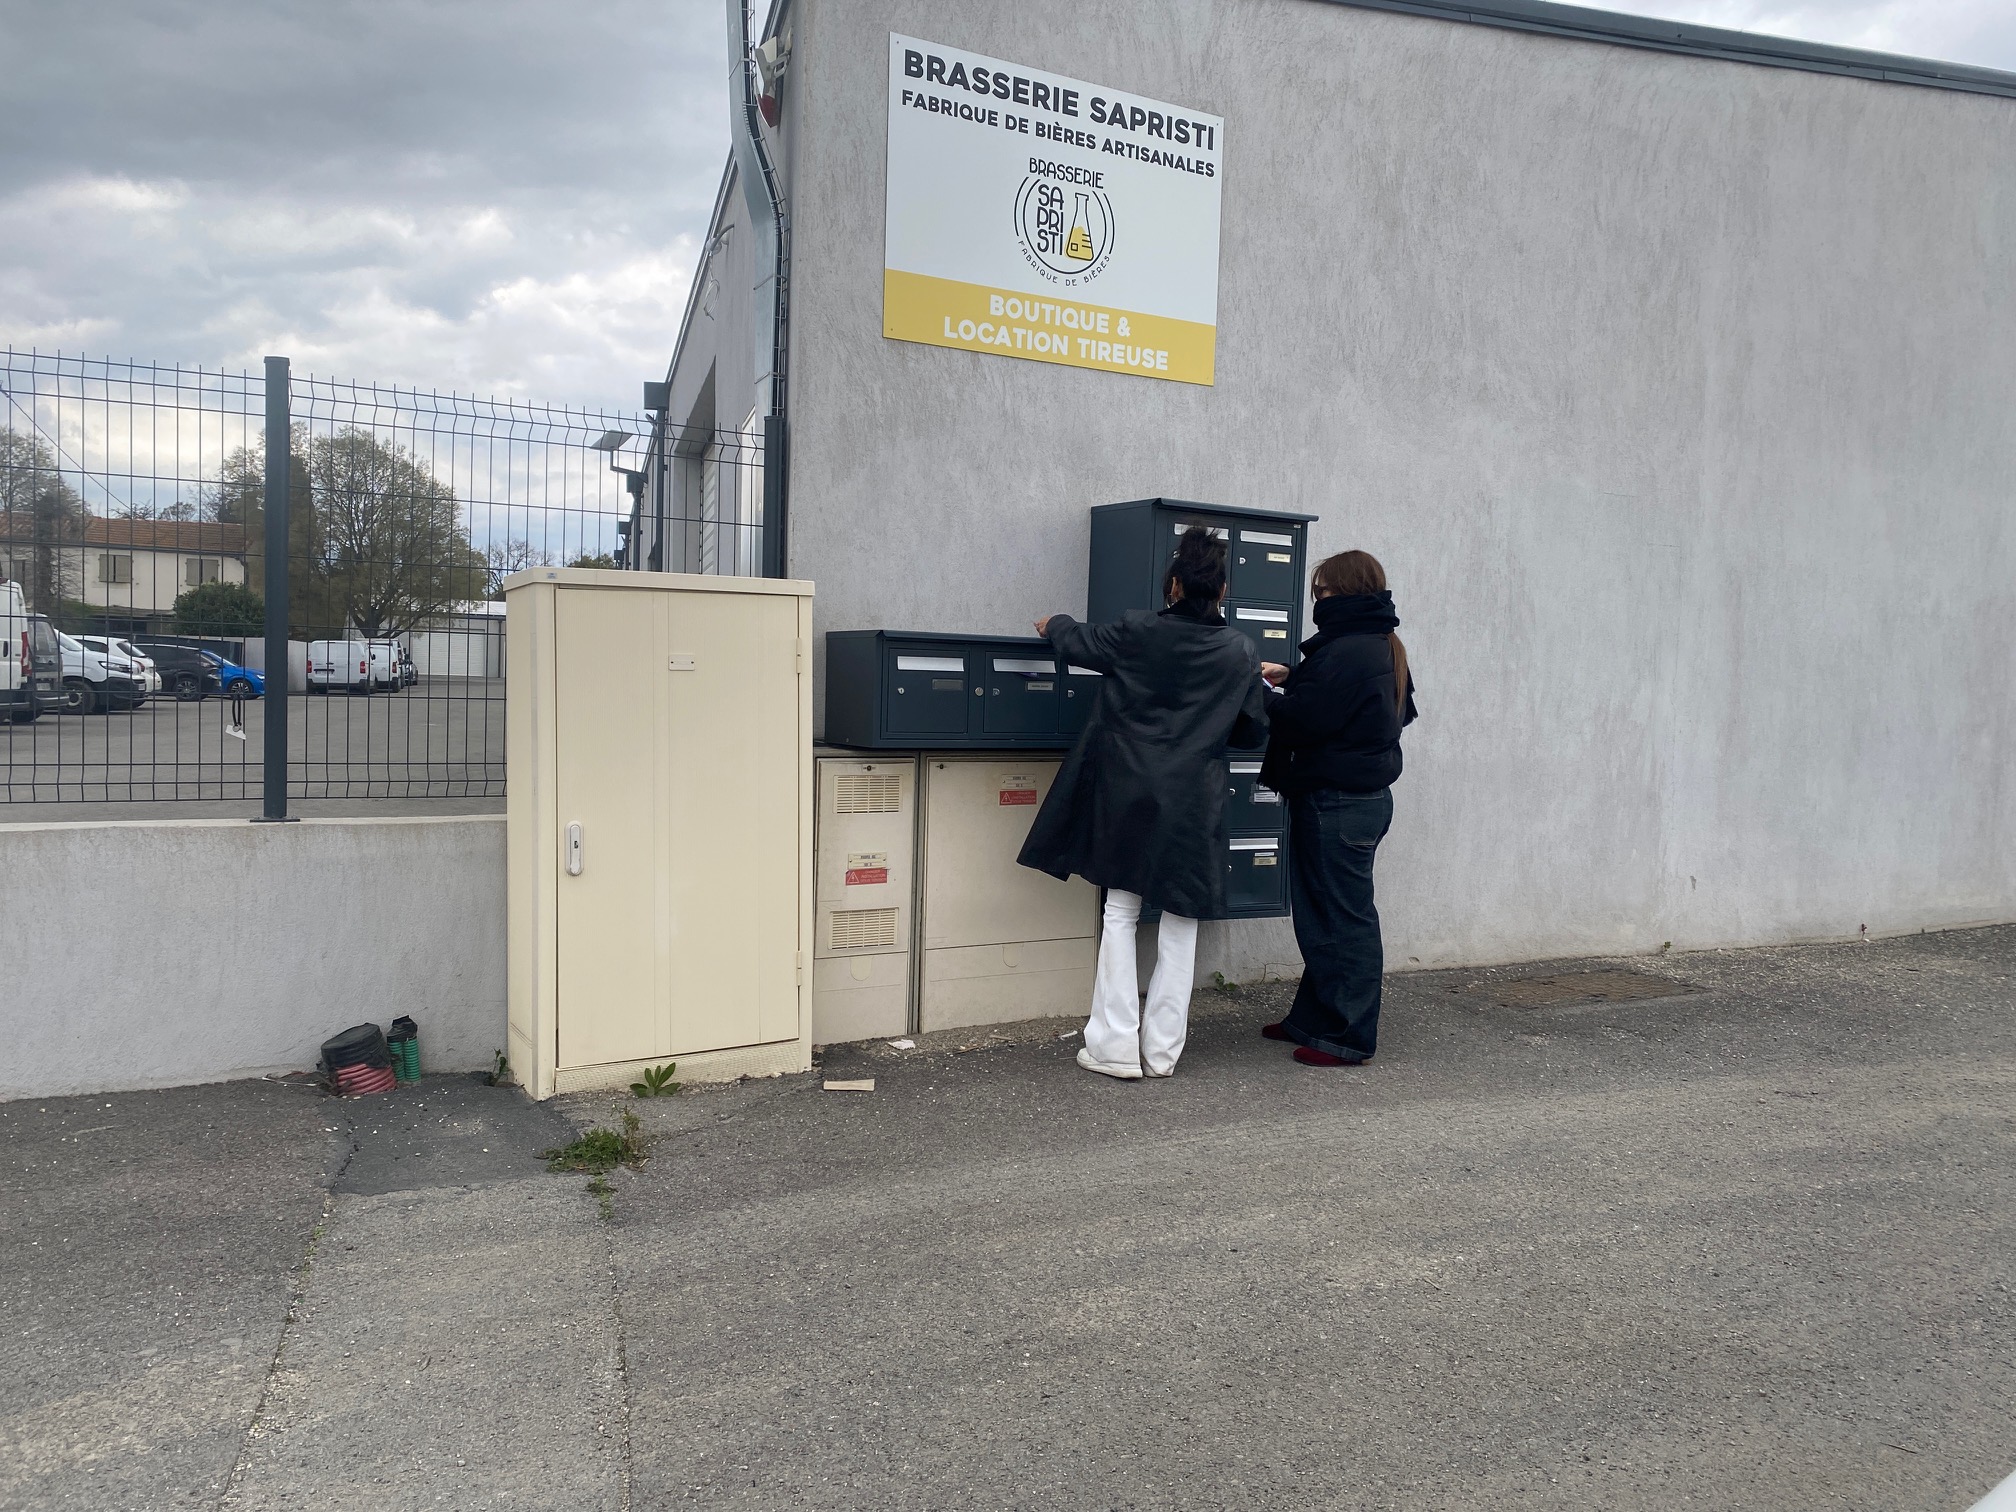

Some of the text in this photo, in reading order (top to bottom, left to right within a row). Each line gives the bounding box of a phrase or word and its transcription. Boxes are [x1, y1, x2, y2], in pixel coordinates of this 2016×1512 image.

[904, 48, 1214, 151] BRASSERIE SAPRISTI
[902, 90, 1215, 178] FABRIQUE DE BIÈRES ARTISANALES
[1029, 157, 1104, 190] BRASSERIE
[1018, 240, 1110, 287] FABRIQUE DE BIÈRES
[990, 294, 1131, 337] BOUTIQUE &
[944, 317, 1168, 371] LOCATION TIREUSE
